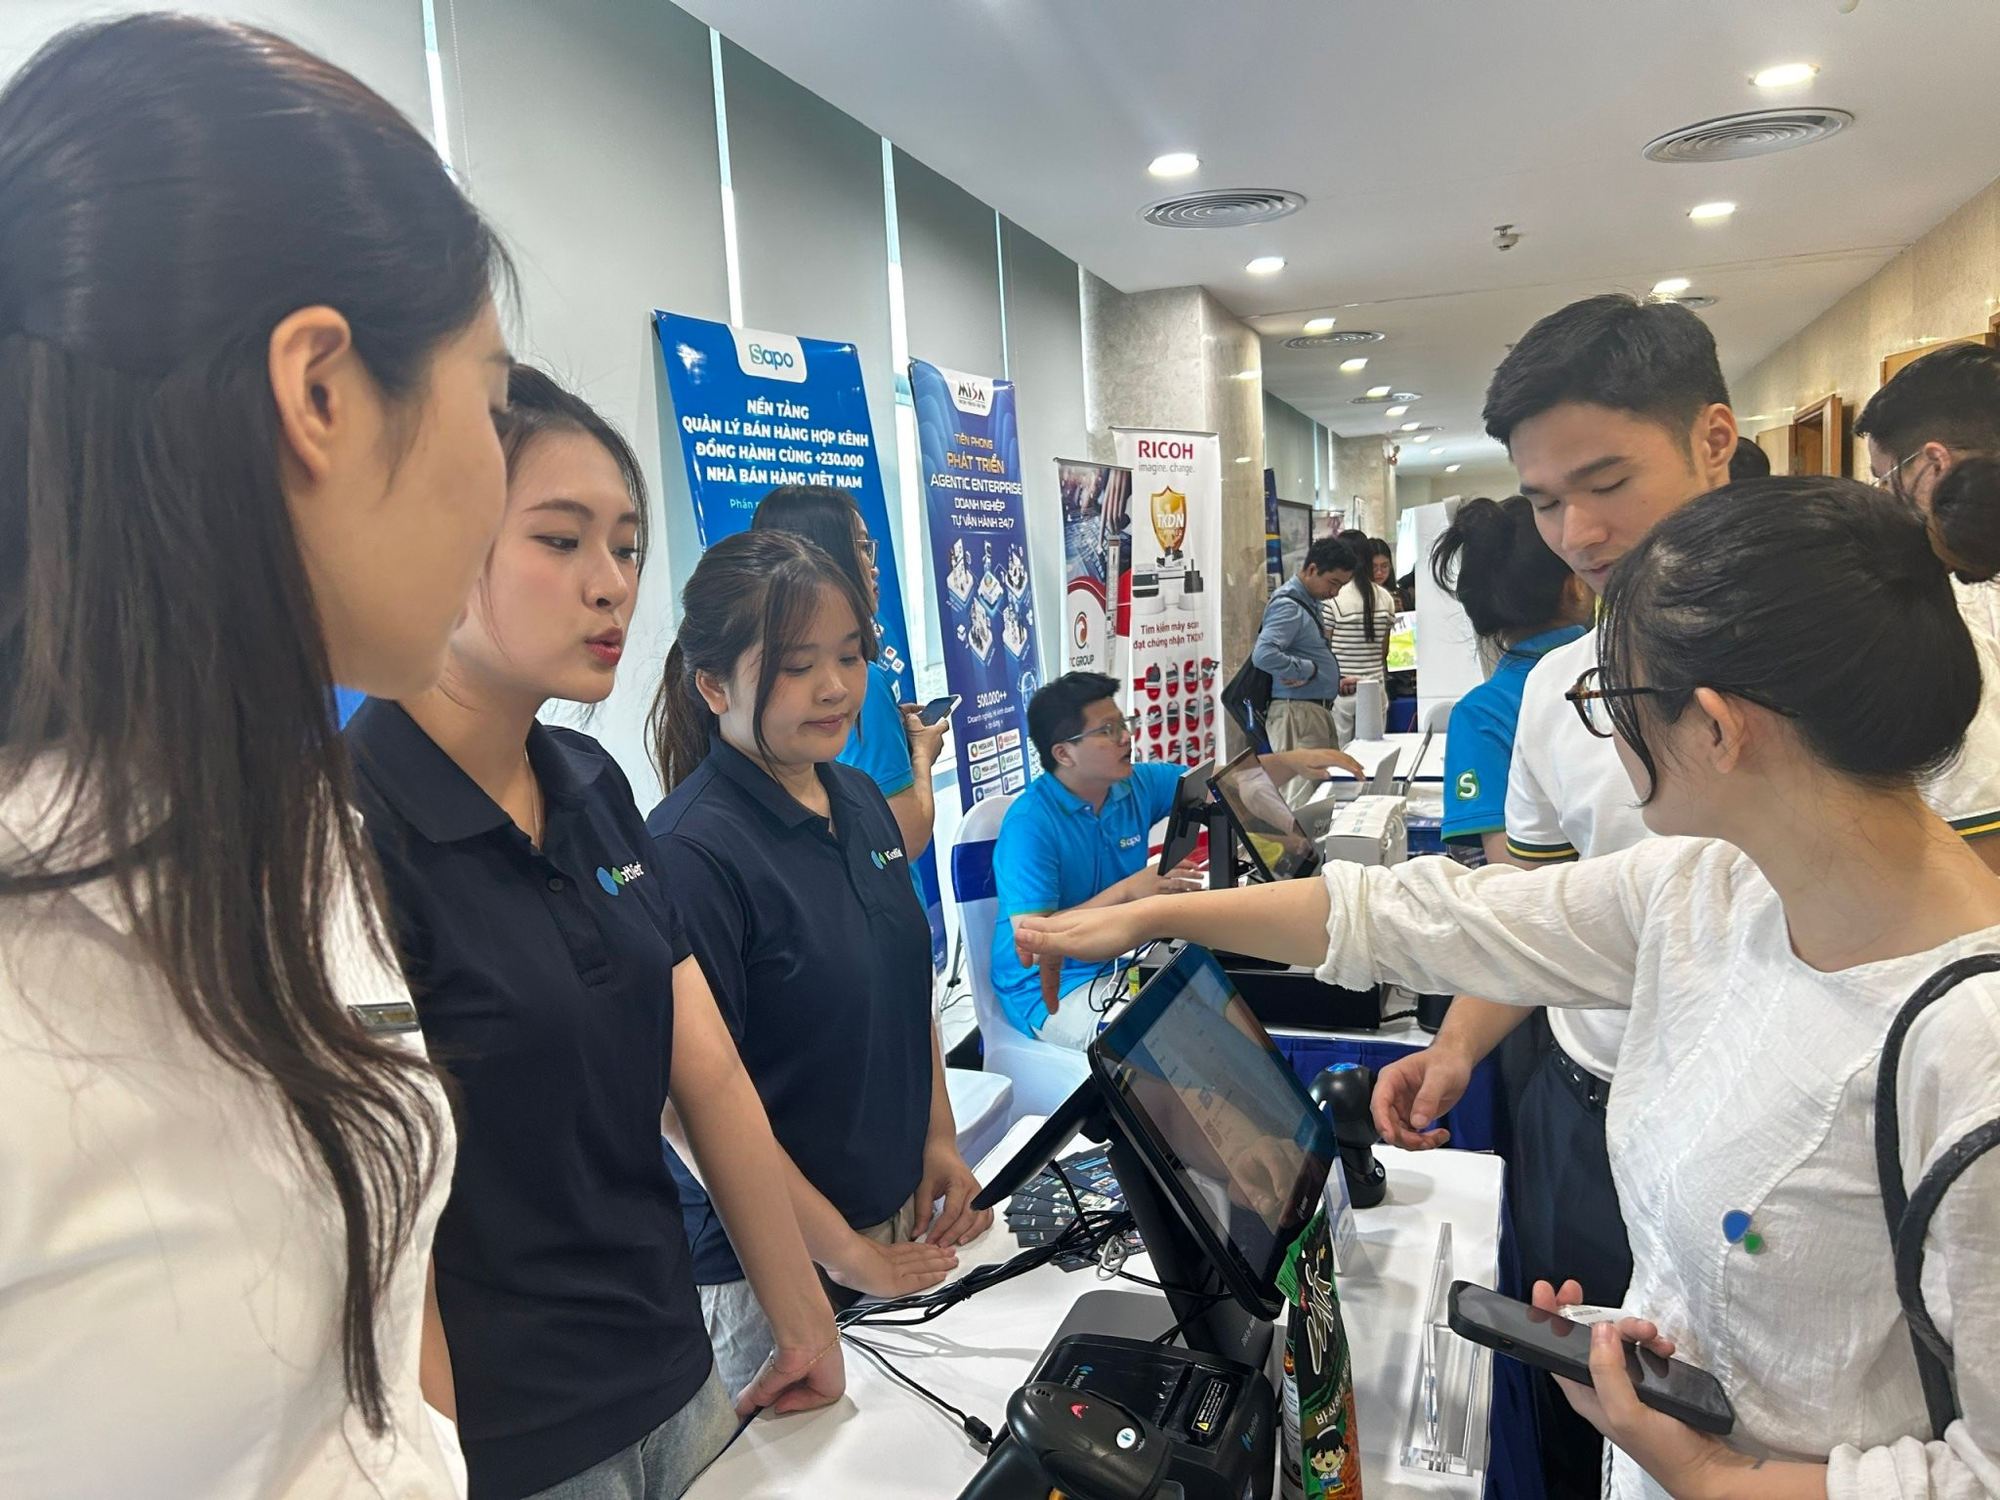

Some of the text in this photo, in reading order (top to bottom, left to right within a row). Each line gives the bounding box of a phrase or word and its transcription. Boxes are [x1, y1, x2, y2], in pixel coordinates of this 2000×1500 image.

[749, 343, 794, 370] Sapo
[958, 382, 985, 401] MISA
[747, 396, 810, 420] NỀN TẢNG
[682, 414, 869, 447] QUẢN LÝ BÁN HÀNG HỢP KÊNH
[695, 438, 864, 468] ĐỒNG HÀNH CÙNG +230.000
[970, 437, 993, 450] PHONG
[1138, 440, 1194, 460] RICOH
[946, 451, 1005, 475] PHÁT TRIỂN
[1138, 461, 1196, 476] imagine. change.
[706, 464, 737, 483] NHÀ
[739, 466, 768, 485] BÁN
[770, 468, 806, 486] HÀNG
[836, 475, 863, 488] NAM
[930, 473, 1023, 495] AGENTIC ENTERPRISE
[954, 497, 1005, 515] DOANH NGHIỆP
[978, 515, 998, 528] HÀNH
[998, 518, 1014, 530] 24/7
[1156, 513, 1185, 528] TKDN
[1076, 654, 1095, 667] GROUP
[1459, 772, 1477, 798] S
[1119, 835, 1141, 848] Sapo
